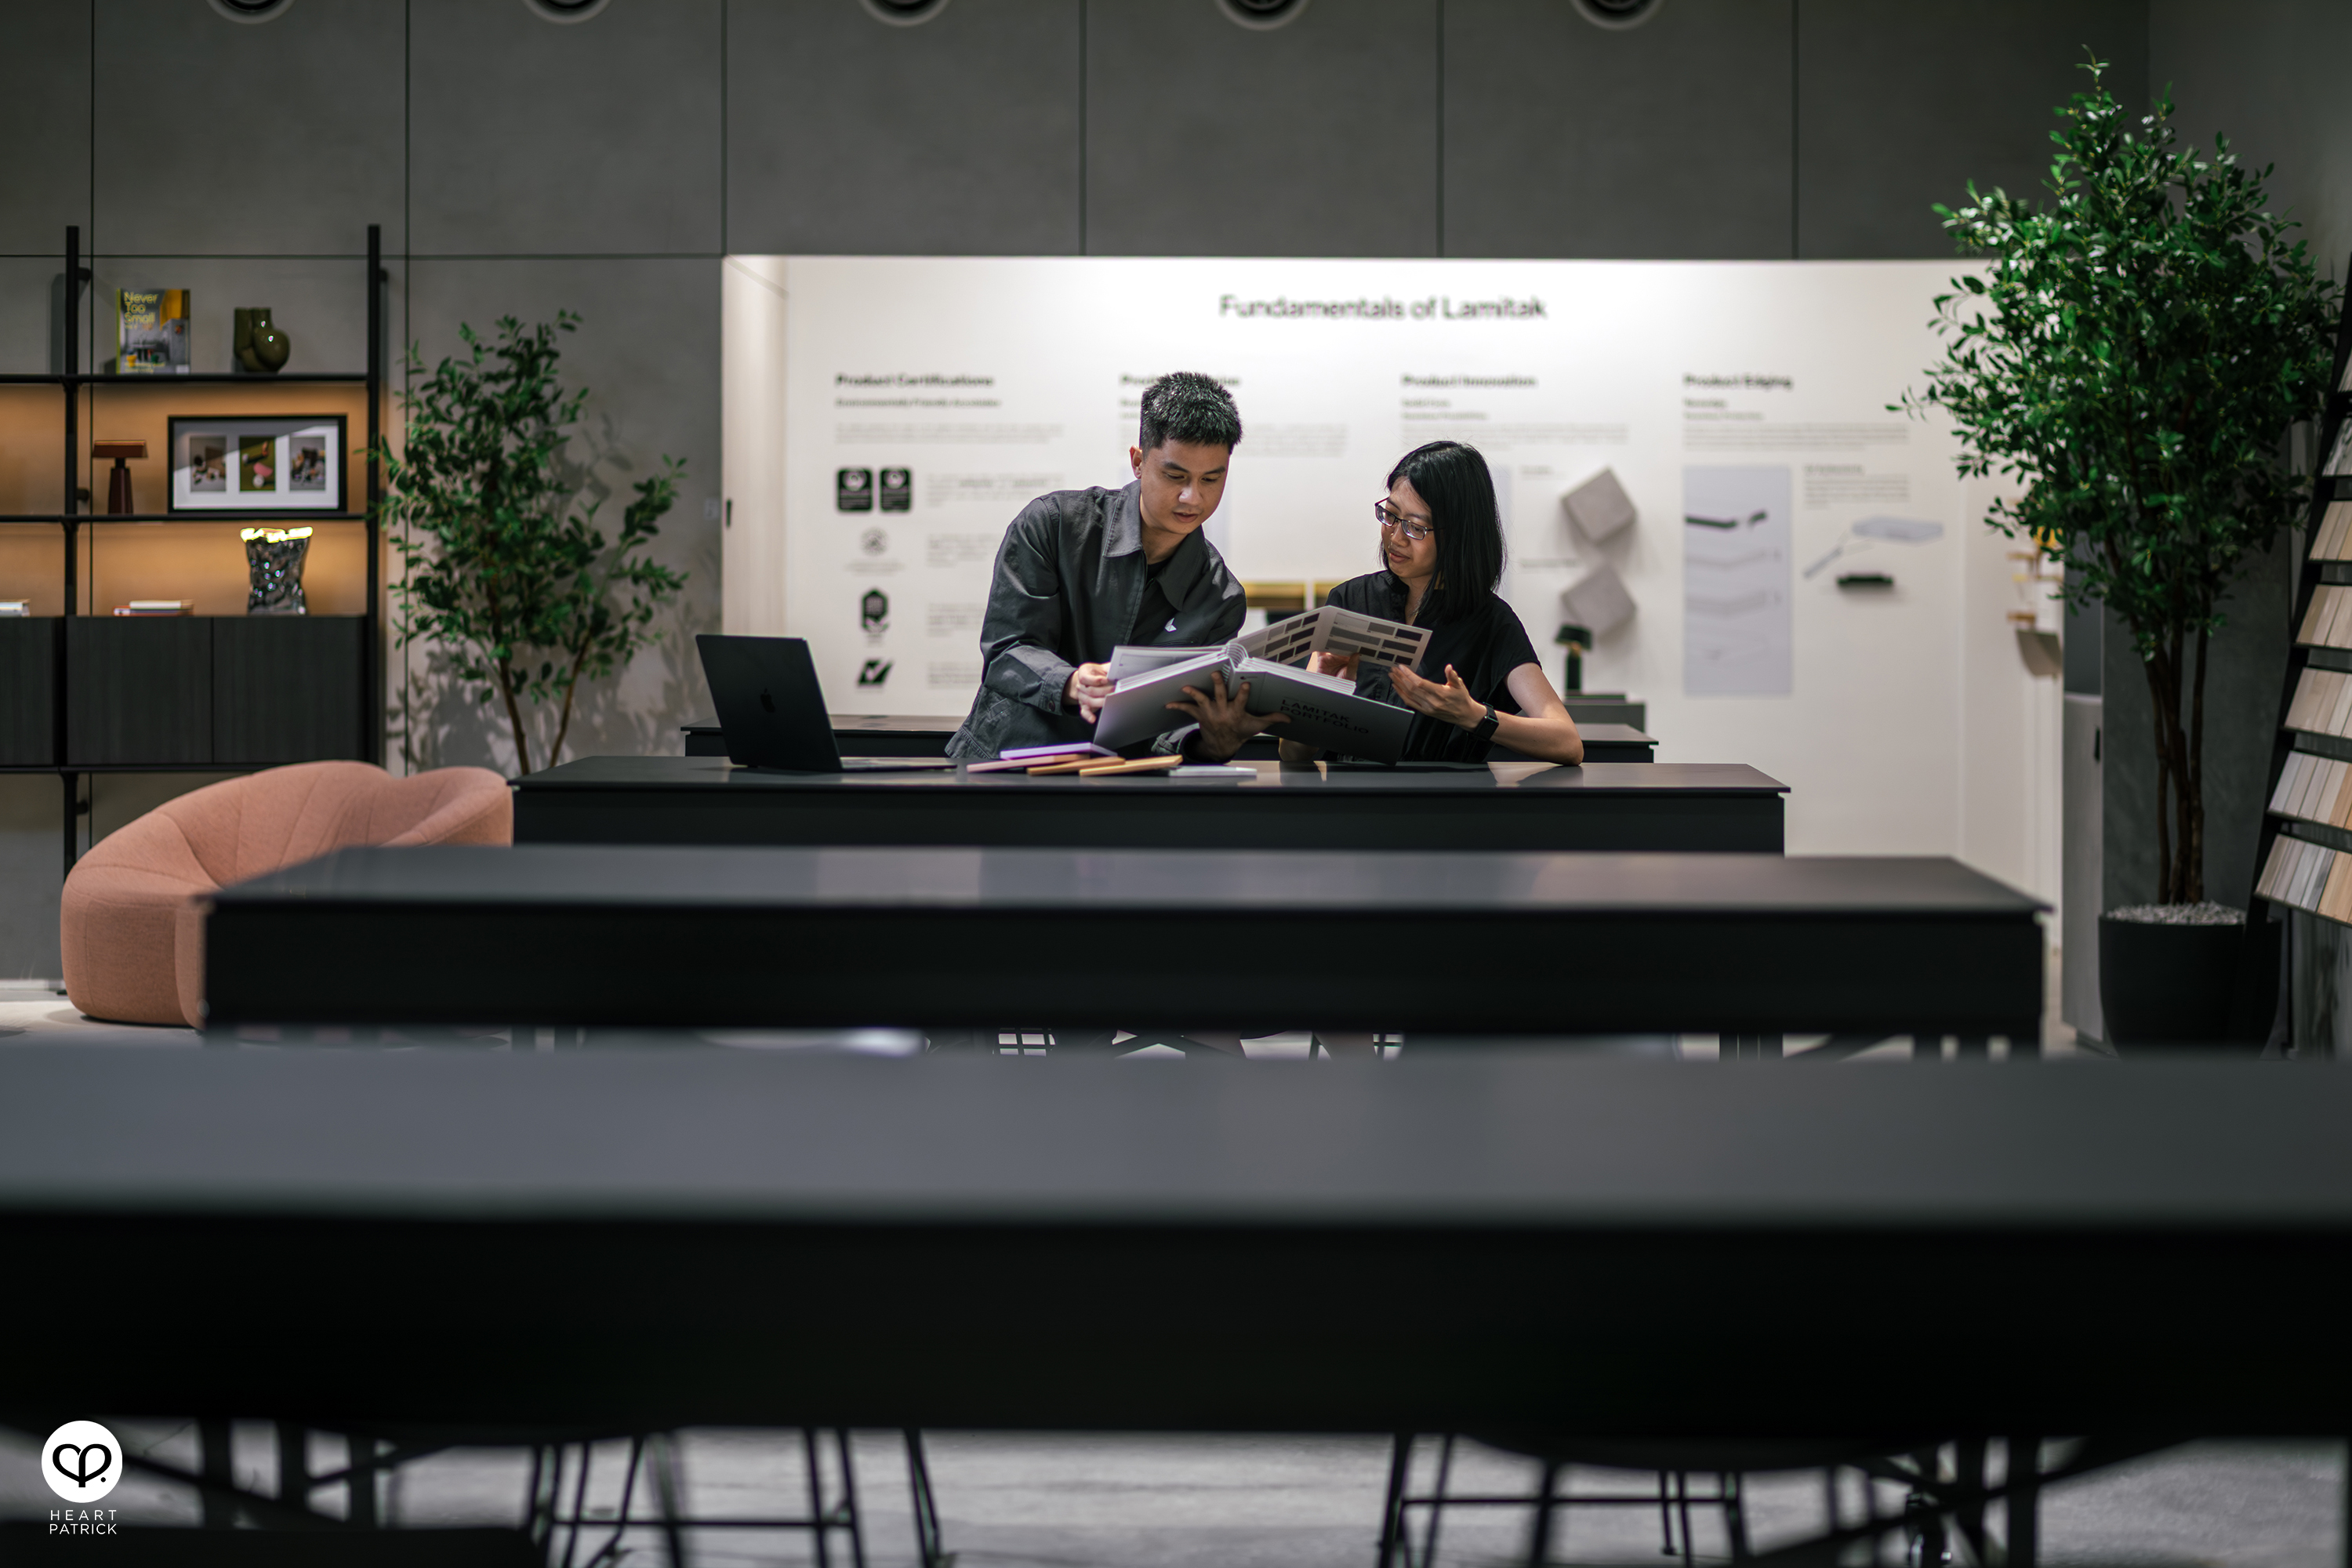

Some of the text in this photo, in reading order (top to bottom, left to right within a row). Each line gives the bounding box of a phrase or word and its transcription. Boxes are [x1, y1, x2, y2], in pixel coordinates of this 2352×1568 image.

[124, 292, 158, 304] Never
[125, 302, 146, 314] Too
[1219, 294, 1548, 321] Fundamentals of Lamitak
[124, 312, 156, 325] Small
[835, 374, 894, 387] Product
[1282, 699, 1350, 723] LAMITAK
[1280, 706, 1369, 734] PORTFOLIO
